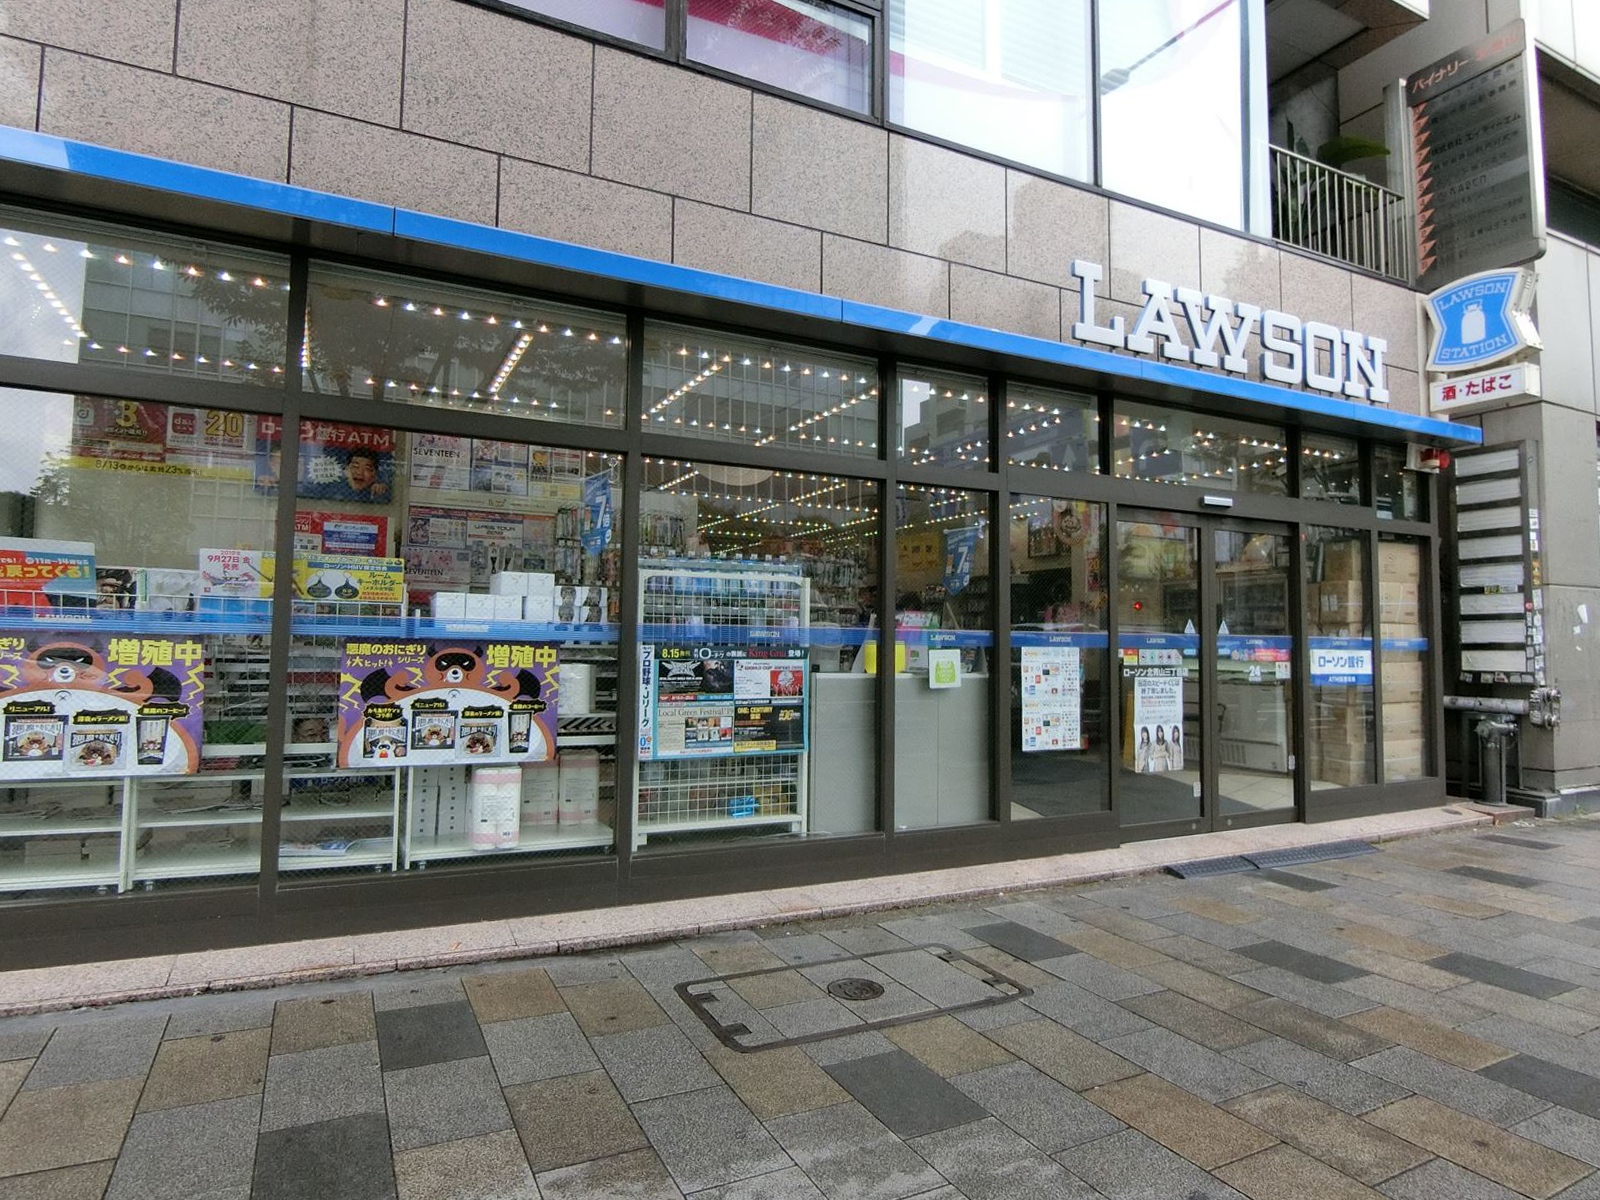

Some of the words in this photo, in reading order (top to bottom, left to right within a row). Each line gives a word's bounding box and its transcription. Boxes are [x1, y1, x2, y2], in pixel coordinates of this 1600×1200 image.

[1438, 281, 1507, 311] LAWSON
[1071, 259, 1391, 403] LAWSON
[1441, 333, 1508, 359] STATION
[1442, 374, 1511, 401] 酒・たばこ
[413, 447, 461, 458] SEVENTEEN
[357, 578, 402, 587] キーホルダー
[108, 638, 203, 667] 増殖中
[345, 642, 427, 656] 悪魔のおにぎり
[486, 644, 557, 669] 増殖中
[397, 656, 425, 664] シリーズ
[1318, 655, 1365, 669] ローソン銀行
[1249, 665, 1261, 677] 24
[641, 650, 651, 728] プロ野球・Jリーグ
[8, 705, 50, 713] リニューアル!
[658, 708, 677, 717] Local
